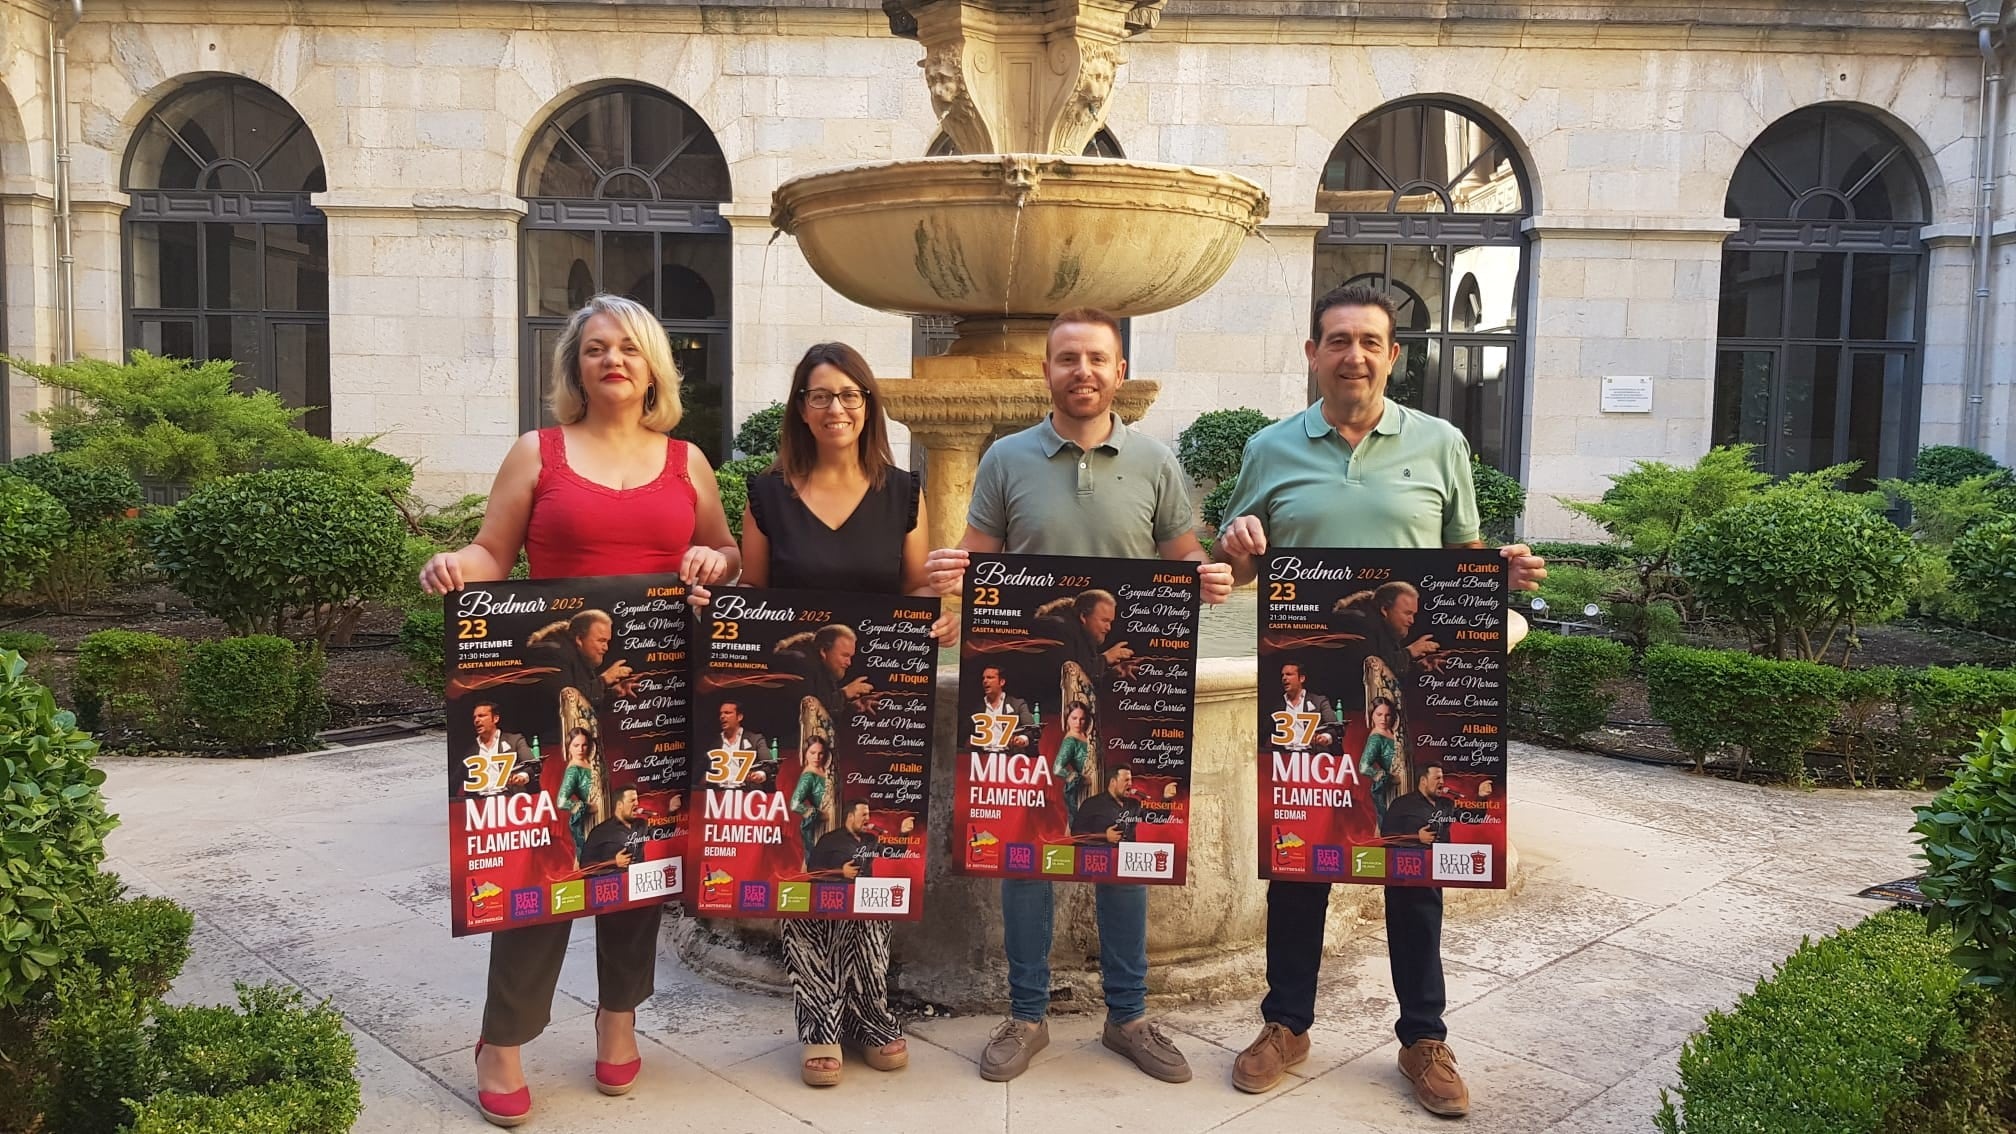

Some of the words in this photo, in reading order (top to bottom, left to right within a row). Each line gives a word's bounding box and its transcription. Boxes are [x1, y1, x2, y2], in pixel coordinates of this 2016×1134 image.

[1269, 556, 1354, 581] Bedmar
[1357, 568, 1391, 580] 2025
[1457, 564, 1468, 573] Al
[1470, 563, 1499, 573] Cante
[974, 562, 1055, 587] Bedmar
[1058, 576, 1091, 587] 2025
[1153, 574, 1162, 583] Al
[1164, 574, 1192, 584] Cante
[1421, 575, 1460, 591] Ezequiel
[647, 588, 656, 597] Al
[658, 586, 685, 596] Cante
[974, 587, 999, 605] 23
[1118, 584, 1156, 600] Ezequiel
[1269, 583, 1296, 601] 23
[457, 590, 547, 618] Bedmar
[551, 597, 585, 610] 2025
[713, 595, 796, 621] Bedmar
[799, 610, 832, 622] 2025
[1270, 603, 1319, 611] SEPTIEMBRE
[893, 609, 903, 618] Al
[905, 610, 932, 619] Cante
[973, 608, 1021, 617] SEPTIEMBRE
[459, 619, 487, 639] 23
[712, 621, 738, 640] 23
[858, 619, 897, 635] Ezequiel
[1456, 631, 1465, 639] Al
[1466, 630, 1499, 640] Toque
[459, 640, 513, 650] SEPTIEMBRE
[712, 642, 761, 651] SEPTIEMBRE
[1149, 638, 1158, 647] Al
[1160, 639, 1189, 649] Toque
[647, 653, 656, 662] Al
[657, 651, 686, 661] Toque
[485, 659, 523, 667] MUNICIPAL
[734, 662, 769, 670] MUNICIPAL
[889, 673, 898, 682] Al
[899, 674, 929, 684] Toque
[1446, 677, 1459, 687] del
[1138, 684, 1150, 693] del
[1118, 699, 1151, 711] Antonio
[1426, 695, 1460, 706] Antonio
[877, 718, 889, 728] del
[1271, 711, 1320, 746] 37
[1462, 725, 1472, 733] Al
[1473, 724, 1497, 733] Baile
[970, 712, 1019, 747] 37
[1151, 729, 1160, 737] Al
[1161, 729, 1184, 738] Baile
[857, 734, 890, 745] Antonio
[1108, 738, 1137, 750] Paula
[1417, 734, 1447, 747] Paula
[654, 743, 663, 752] Al
[706, 748, 757, 784] 37
[889, 763, 899, 772] Al
[900, 763, 922, 772] Baile
[969, 752, 1052, 785] MIGA
[1272, 752, 1359, 784] MIGA
[463, 752, 517, 792] 37
[846, 772, 876, 784] Paula
[970, 787, 1045, 807] FLAMENCA
[1274, 787, 1352, 807] FLAMENCA
[704, 788, 789, 821] MIGA
[1140, 800, 1183, 810] Presenta
[1454, 800, 1500, 809] Presenta
[466, 790, 557, 831] MIGA
[970, 808, 1001, 819] BEDMAR
[1274, 809, 1306, 820] BEDMAR
[647, 813, 689, 827] Presenta
[704, 824, 782, 844] FLAMENCA
[877, 835, 920, 844] Presenta
[468, 827, 551, 856] FLAMENCA
[704, 846, 736, 857] BEDMAR
[1125, 852, 1153, 863] BED
[1440, 853, 1469, 864] BED
[469, 856, 503, 871] BEDMAR
[1124, 861, 1152, 872] MAR
[1439, 864, 1470, 875] MAR
[636, 871, 663, 884] BED
[635, 879, 663, 894] MAR
[861, 887, 890, 899] BED
[860, 896, 888, 908] MAR
